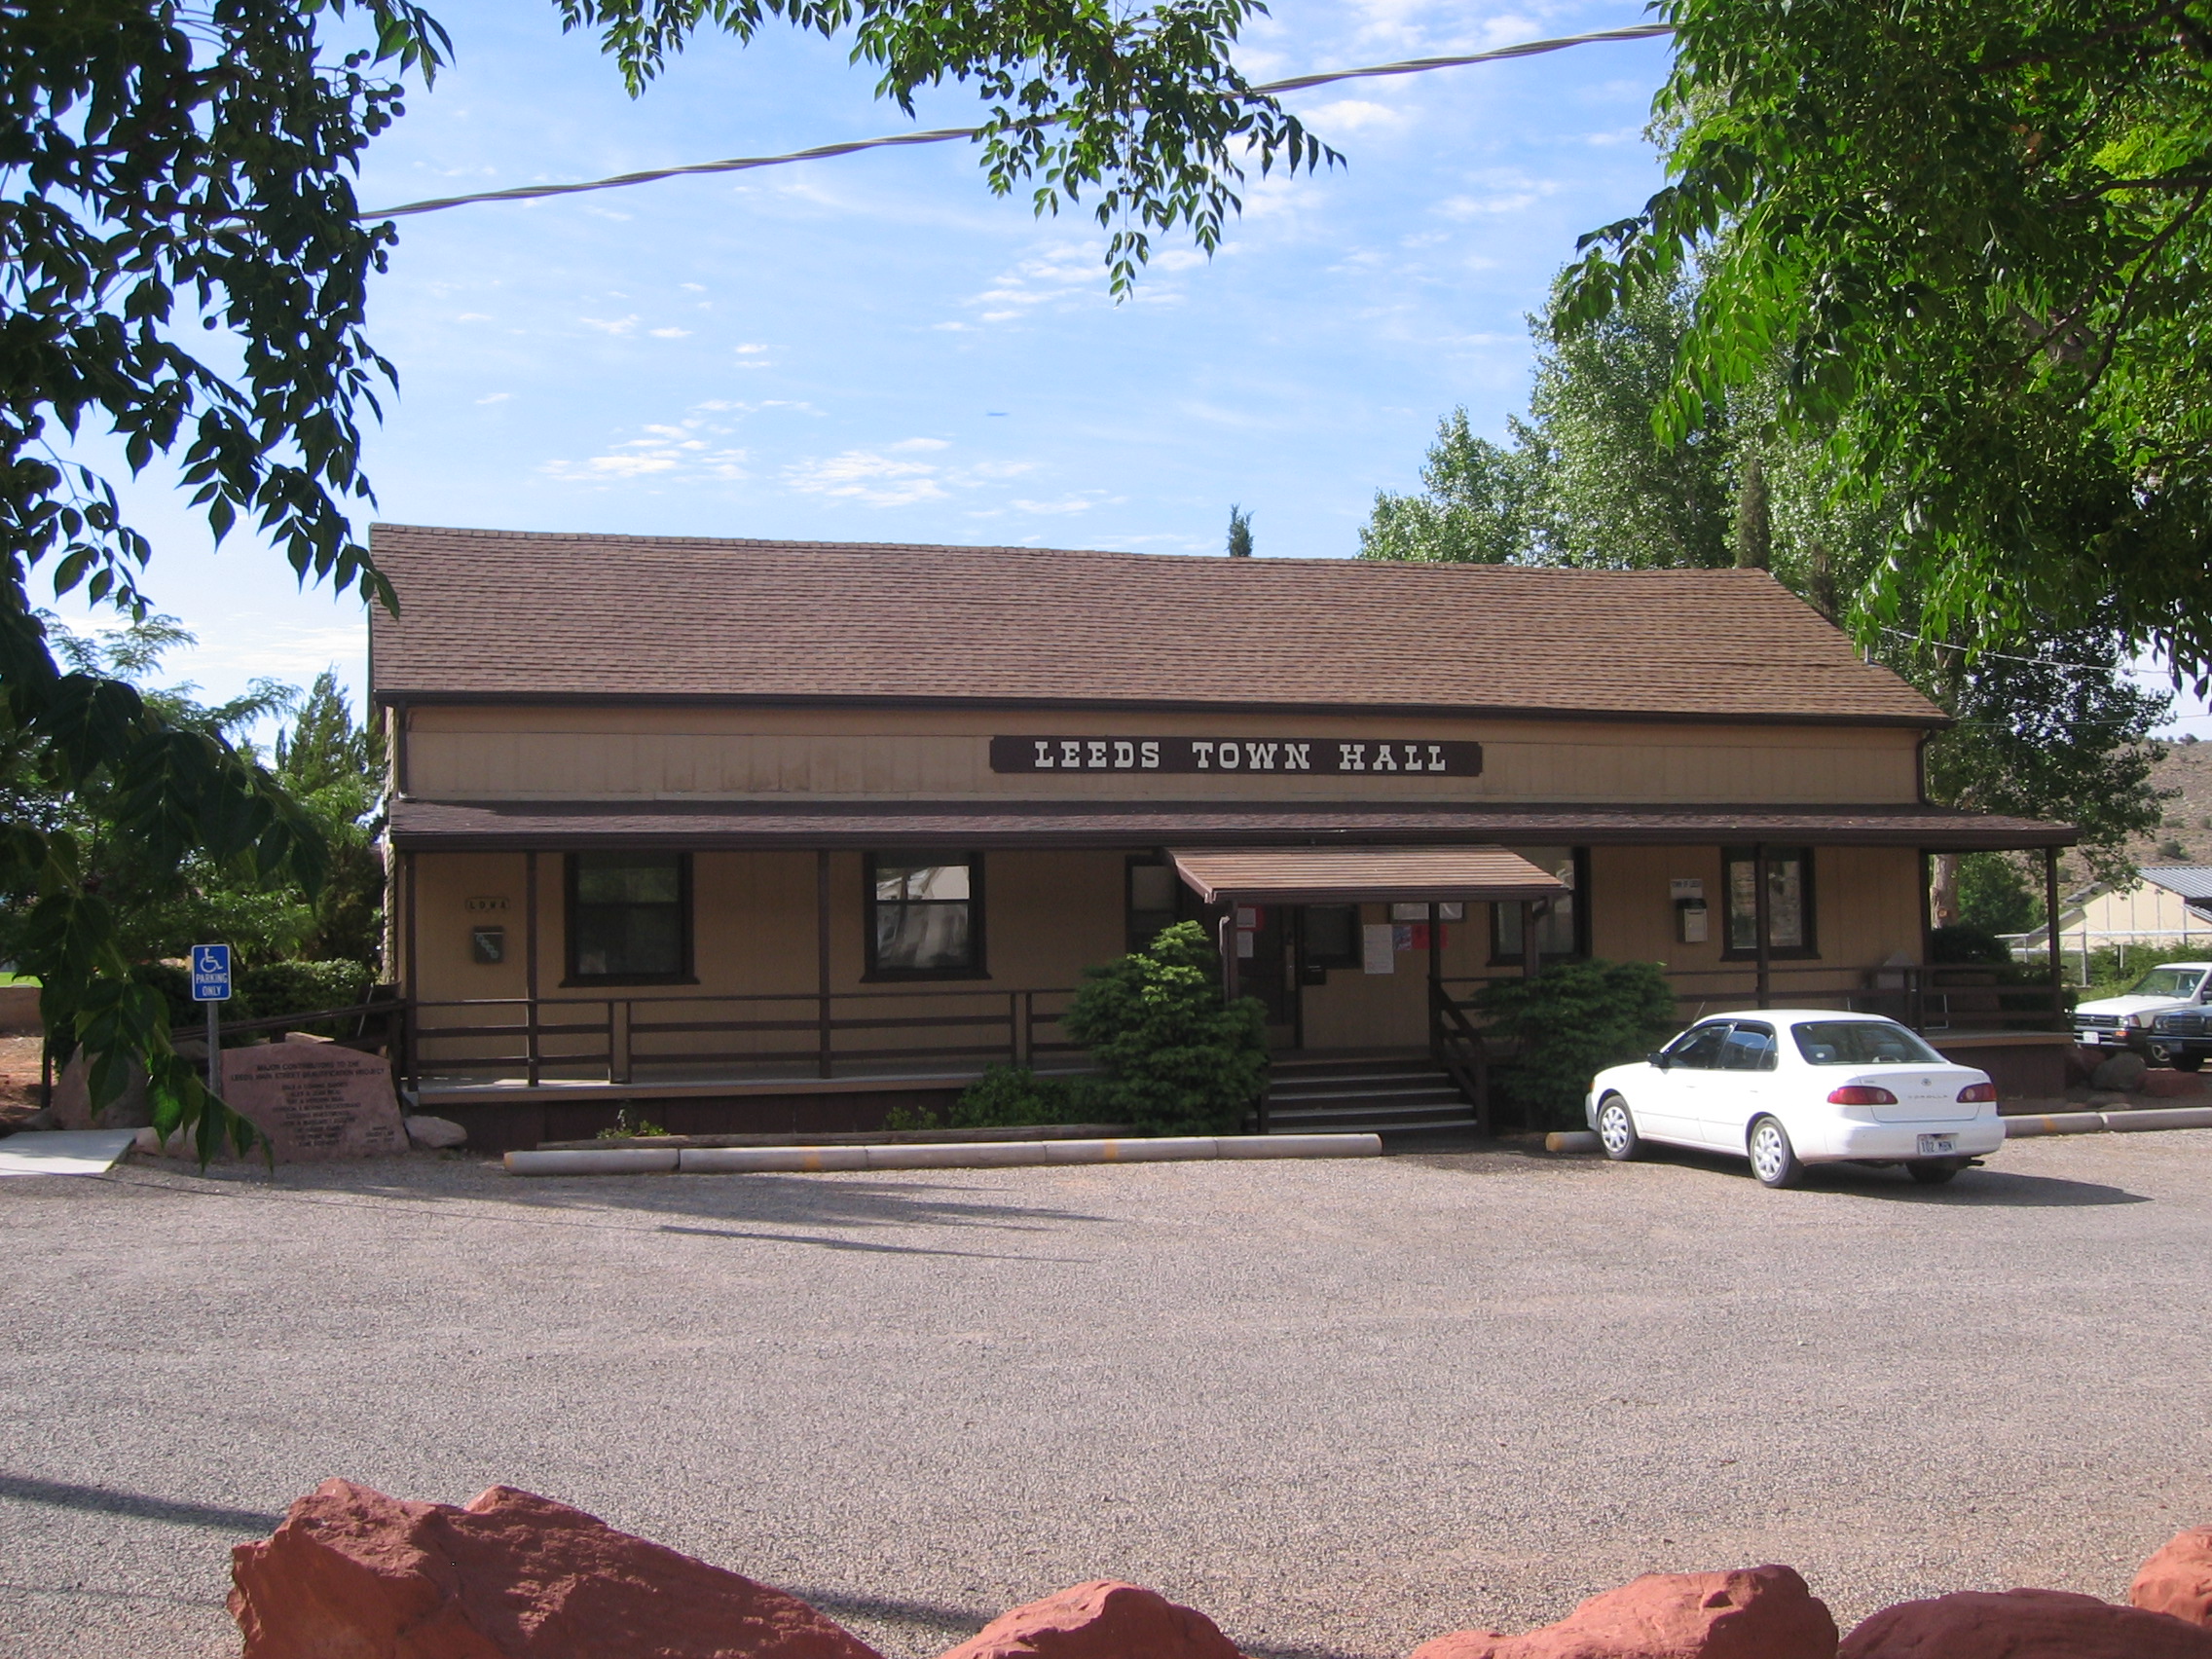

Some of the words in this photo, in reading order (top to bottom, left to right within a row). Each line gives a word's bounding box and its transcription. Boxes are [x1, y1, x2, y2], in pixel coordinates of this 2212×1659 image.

[1034, 740, 1161, 768] LEEDS
[1192, 742, 1311, 769] TOWN
[1339, 743, 1447, 771] HALL
[196, 973, 228, 984] PARKING
[202, 985, 222, 997] ONLY
